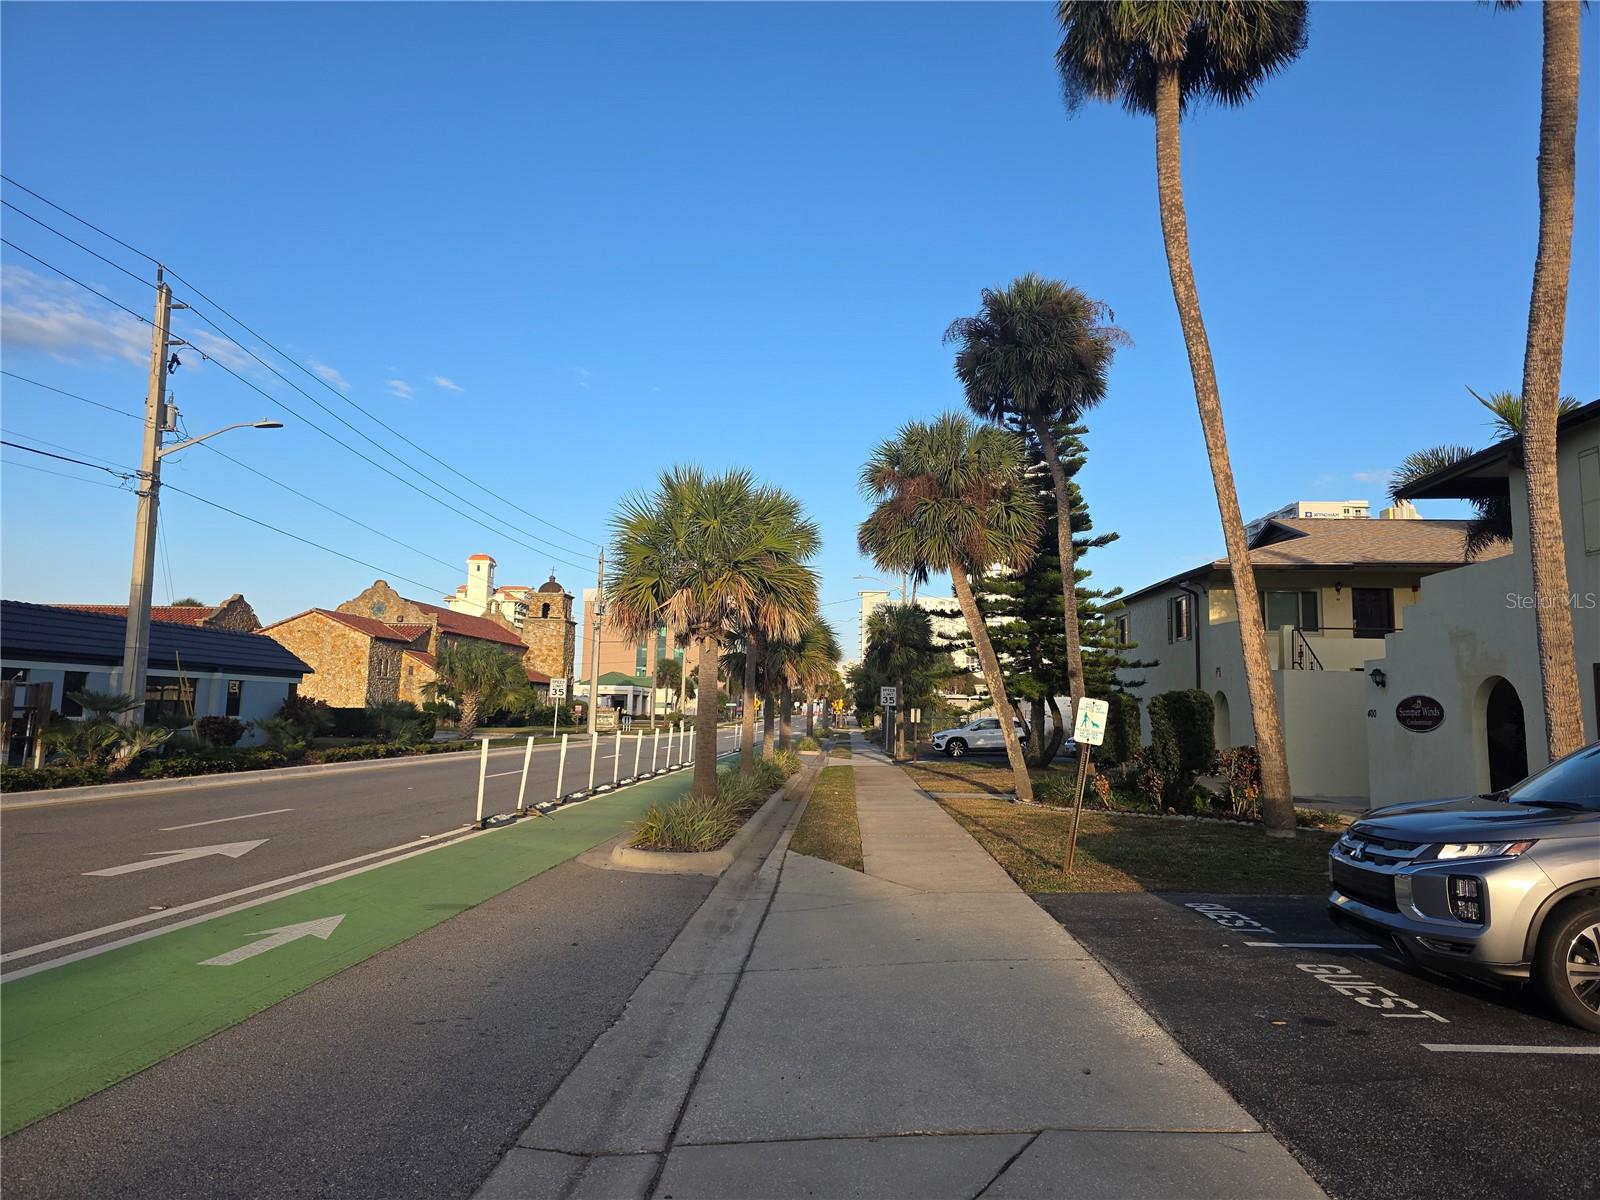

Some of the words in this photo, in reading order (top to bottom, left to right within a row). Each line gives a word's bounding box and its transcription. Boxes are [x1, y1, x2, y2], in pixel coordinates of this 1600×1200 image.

[551, 688, 565, 696] 35
[882, 696, 895, 704] 35
[1184, 903, 1276, 934] GUEST
[1296, 963, 1450, 1023] GUEST
